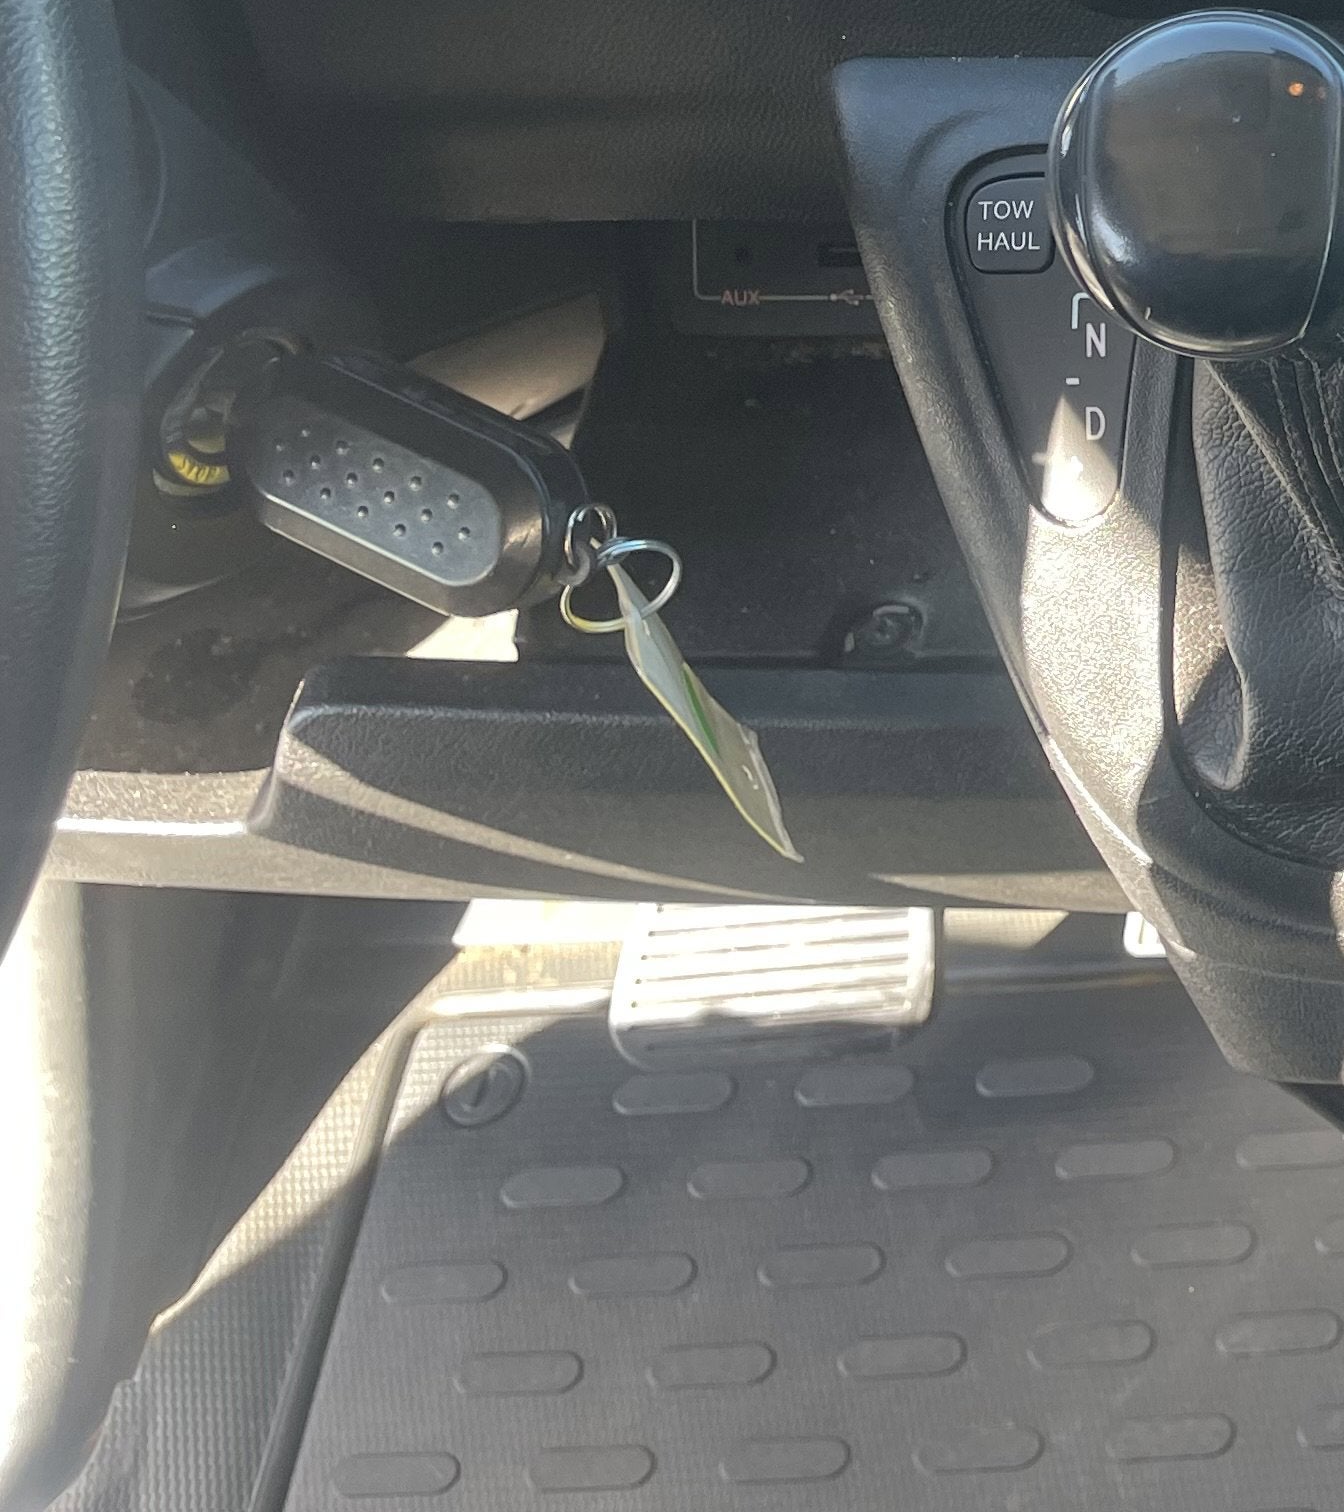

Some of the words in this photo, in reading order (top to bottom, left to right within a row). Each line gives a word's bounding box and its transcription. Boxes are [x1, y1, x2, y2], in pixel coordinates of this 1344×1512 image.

[978, 200, 1034, 220] TOW
[977, 231, 1040, 251] HAUL
[720, 289, 760, 308] AUX
[1086, 322, 1106, 358] N
[1084, 406, 1107, 442] D
